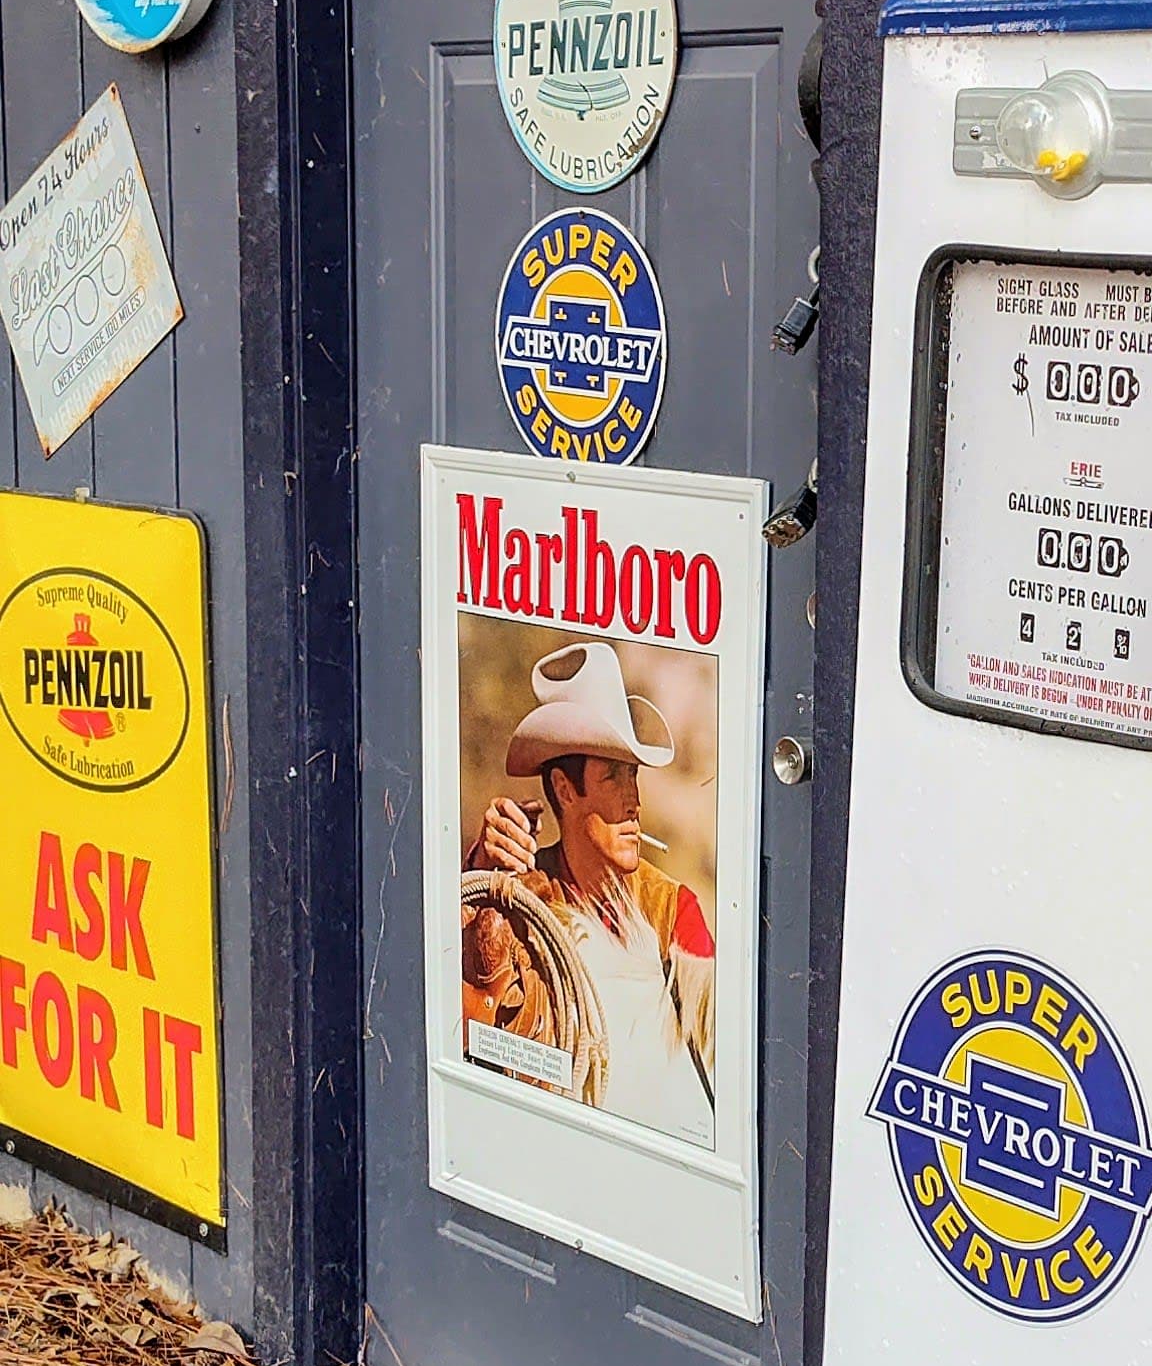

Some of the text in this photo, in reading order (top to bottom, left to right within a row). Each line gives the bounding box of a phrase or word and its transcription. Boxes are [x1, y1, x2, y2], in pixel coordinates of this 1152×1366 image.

[507, 8, 666, 78] PENNZOIL
[509, 84, 661, 181] SAFE LUBRICATION
[0, 117, 111, 251] Open 24 Hours
[10, 167, 136, 331] Last Chance
[522, 224, 638, 296] SUPER
[996, 297, 1043, 315] BEFORE
[1050, 301, 1077, 317] AND
[1084, 302, 1126, 321] AFTER
[997, 278, 1033, 296] SIGHT
[1039, 280, 1079, 299] GLASS
[1105, 284, 1139, 303] MUST
[57, 292, 142, 391] NEXT SERVICE 100 MILES
[508, 326, 652, 370] CHEVROLET
[1029, 325, 1090, 350] AMOUNT
[1095, 330, 1114, 351] OF
[1011, 353, 1029, 396] $
[516, 385, 642, 463] SERVICE
[1055, 411, 1120, 427] TAX INCLUDED
[1070, 461, 1102, 478] ERIE
[1008, 492, 1071, 517] GALLONS
[456, 493, 723, 645] Marlboro
[36, 583, 130, 625] Supreme Quality
[1008, 578, 1147, 618] CENTS PER GALLON
[23, 647, 153, 710] PENNZOIL
[1002, 660, 1019, 677] AND
[1022, 663, 1046, 682] SALES
[1049, 667, 1097, 692] INDICATION
[1100, 676, 1125, 696] MUST
[1127, 684, 1138, 700] BE
[1140, 687, 1152, 702] AT
[1041, 651, 1105, 671] TAX INCLUDED
[968, 672, 991, 689] WHEN
[993, 675, 1031, 697] DELIVERY
[1032, 683, 1039, 699] IS
[1041, 685, 1068, 705] BEGUN
[1076, 693, 1104, 711] UNDER
[1106, 696, 1142, 719] PENALTY
[43, 735, 135, 780] Safe Lubrication
[31, 830, 156, 981] ASK
[0, 954, 203, 1142] FOR IT
[940, 970, 1097, 1074] SUPER
[893, 1079, 1140, 1196] CHEVROLET
[914, 1165, 1113, 1301] SERVICE
